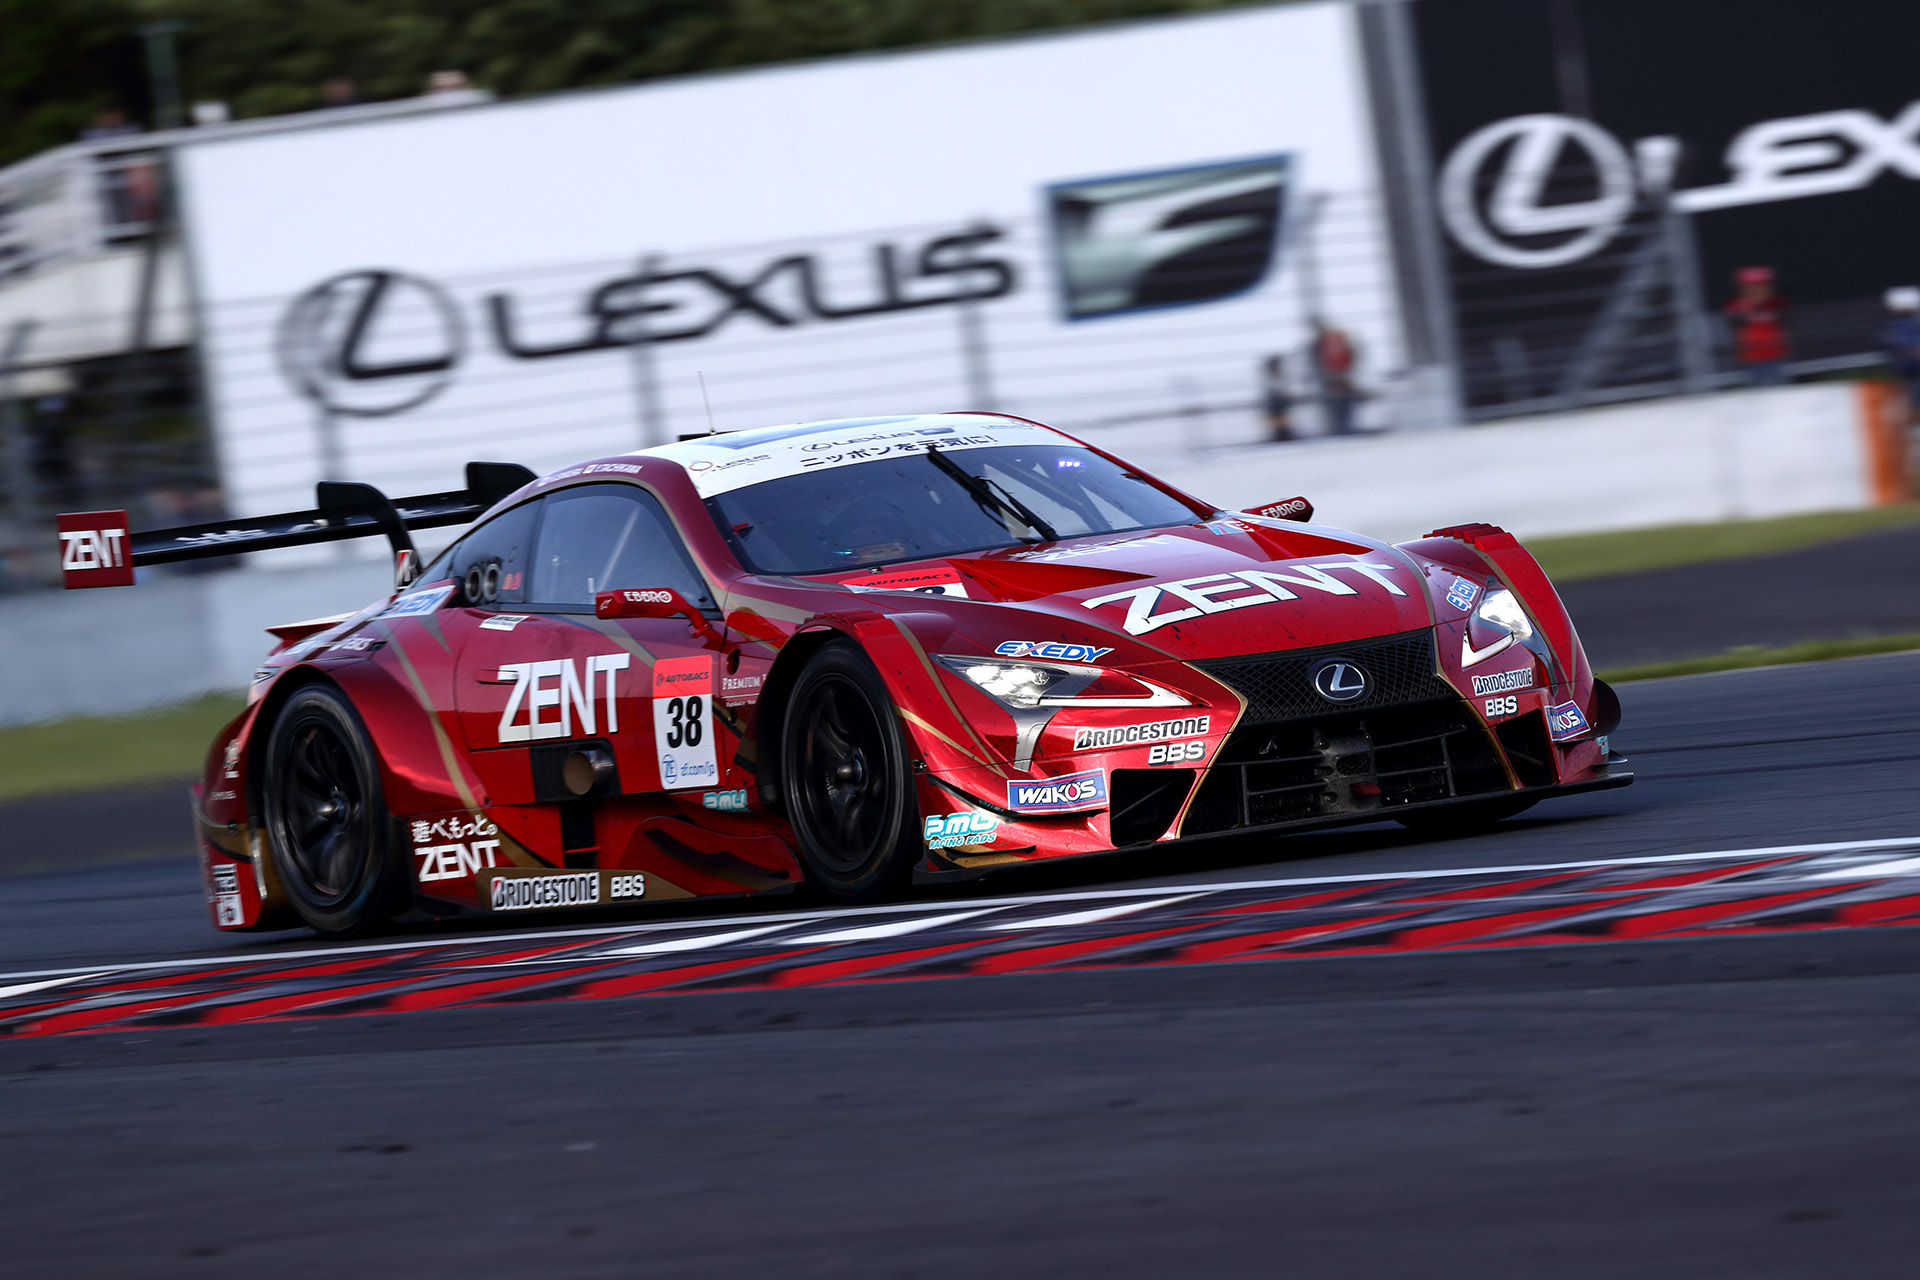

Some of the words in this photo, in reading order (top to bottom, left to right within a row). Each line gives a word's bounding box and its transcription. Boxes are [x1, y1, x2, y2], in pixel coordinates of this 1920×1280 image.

[487, 228, 1018, 359] LEXUS
[833, 430, 915, 446] LEXUS
[1261, 500, 1306, 518] EBBRO
[58, 528, 126, 571] ZENT
[865, 573, 953, 587] AUTOBACS
[623, 591, 673, 603] EBBRO
[1080, 554, 1409, 636] ZENT
[1447, 575, 1479, 612] EXEDY
[995, 641, 1115, 663] EXEDY
[664, 671, 709, 684] AUTOBACS
[1473, 669, 1532, 695] BRIDGESTONE
[497, 652, 631, 743] ZENT
[1485, 695, 1518, 717] BBS
[666, 695, 703, 749] 38
[1075, 716, 1209, 749] BRIDGESTONE
[1148, 740, 1204, 765] BBS
[680, 761, 715, 777] zf.com/jp
[1018, 779, 1097, 805] WAKO'S
[929, 838, 964, 850] RACING
[965, 834, 997, 846] PADS
[414, 839, 501, 883] ZENT
[492, 873, 598, 910] BRIDGESTONE
[610, 875, 645, 899] BBS
